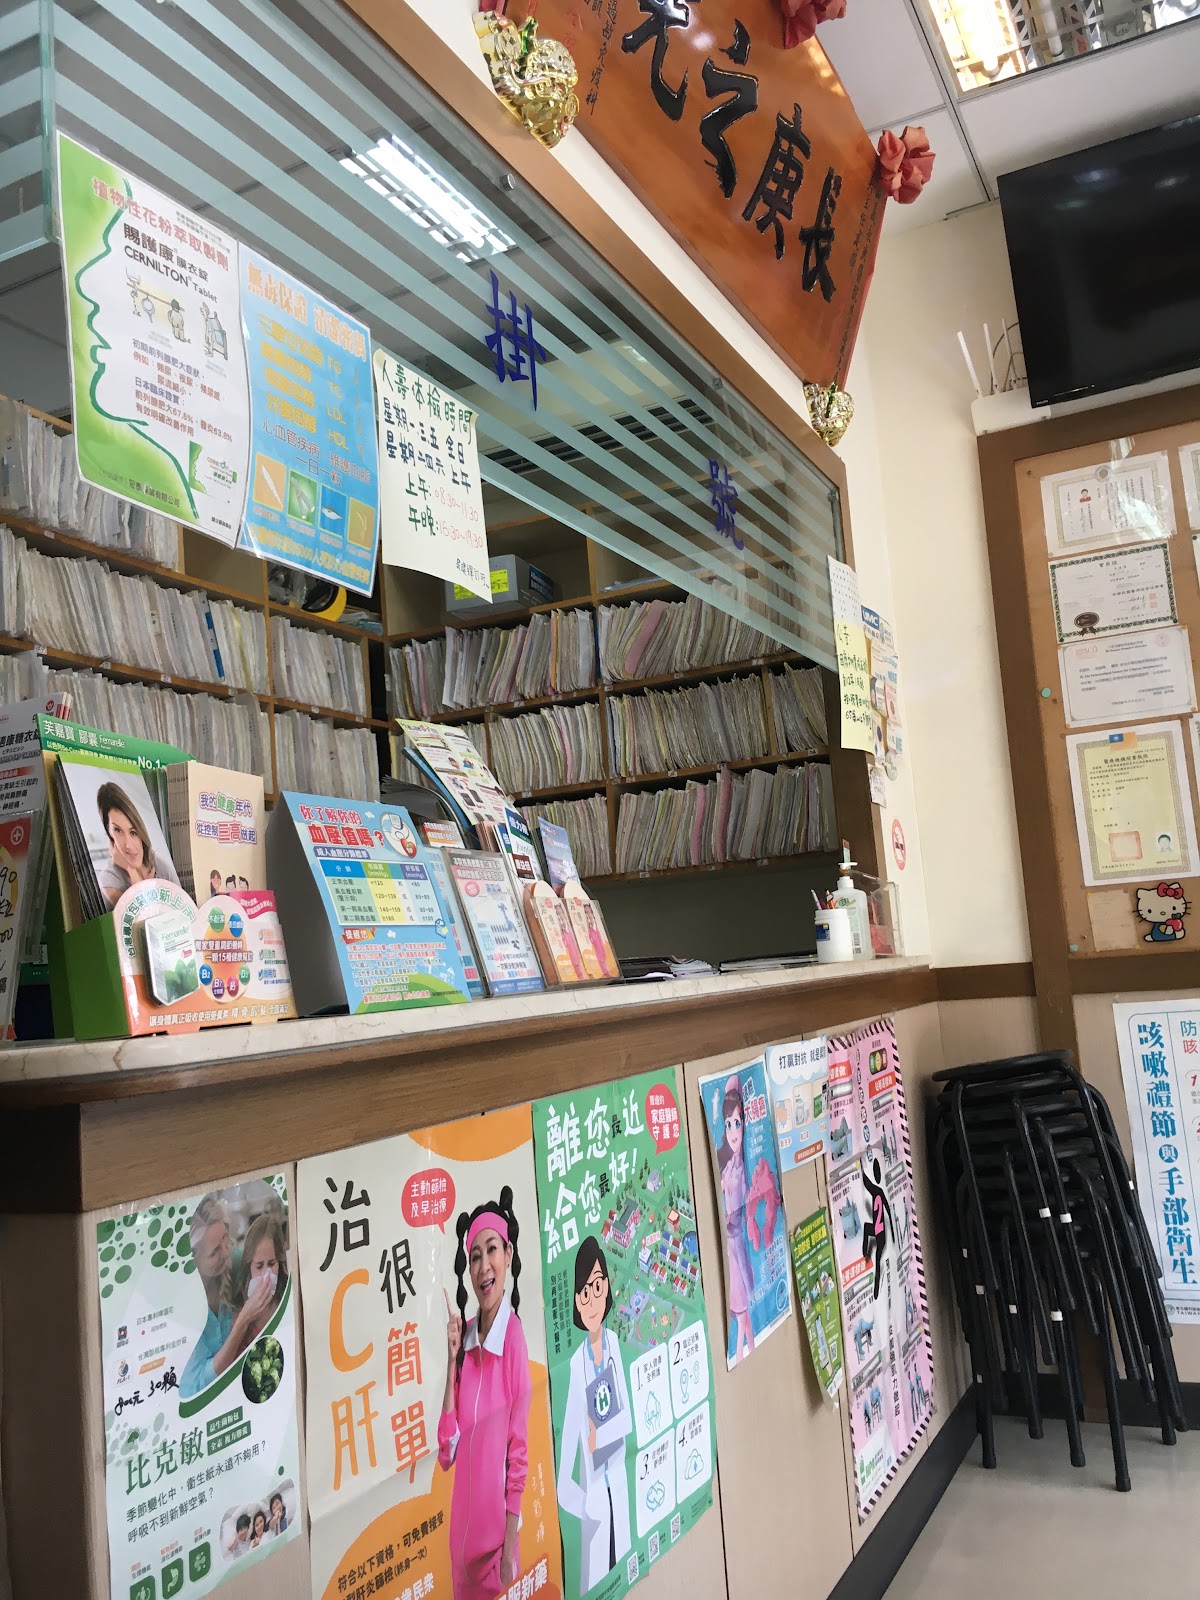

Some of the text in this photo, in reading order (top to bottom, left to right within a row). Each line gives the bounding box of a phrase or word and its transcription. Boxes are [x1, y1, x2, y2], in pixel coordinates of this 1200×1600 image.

[93, 177, 229, 272] 植物性花粉萃取製劑
[192, 282, 218, 304] Tablet
[485, 269, 547, 411] 掛
[708, 458, 744, 551] 號
[446, 435, 464, 464] 全日
[452, 469, 472, 495] 上午
[138, 755, 160, 770] No.1
[300, 804, 363, 825] 你了解你的
[202, 968, 211, 979] B2
[650, 1107, 679, 1124] 家庭醫師
[547, 1089, 645, 1183] 離您最近
[651, 1123, 680, 1141] 守護您
[1137, 1021, 1198, 1285] 咳嗽禮節與手部衛生
[410, 1177, 447, 1198] 主動篩檢
[410, 1197, 447, 1218] 及早治療
[874, 1195, 885, 1236] 2
[319, 1177, 378, 1492] 治C肝
[380, 1239, 432, 1484] 很簡單
[125, 1426, 204, 1496] 比克敏
[127, 1487, 215, 1544] 呼吸不到新鮮空氣？
